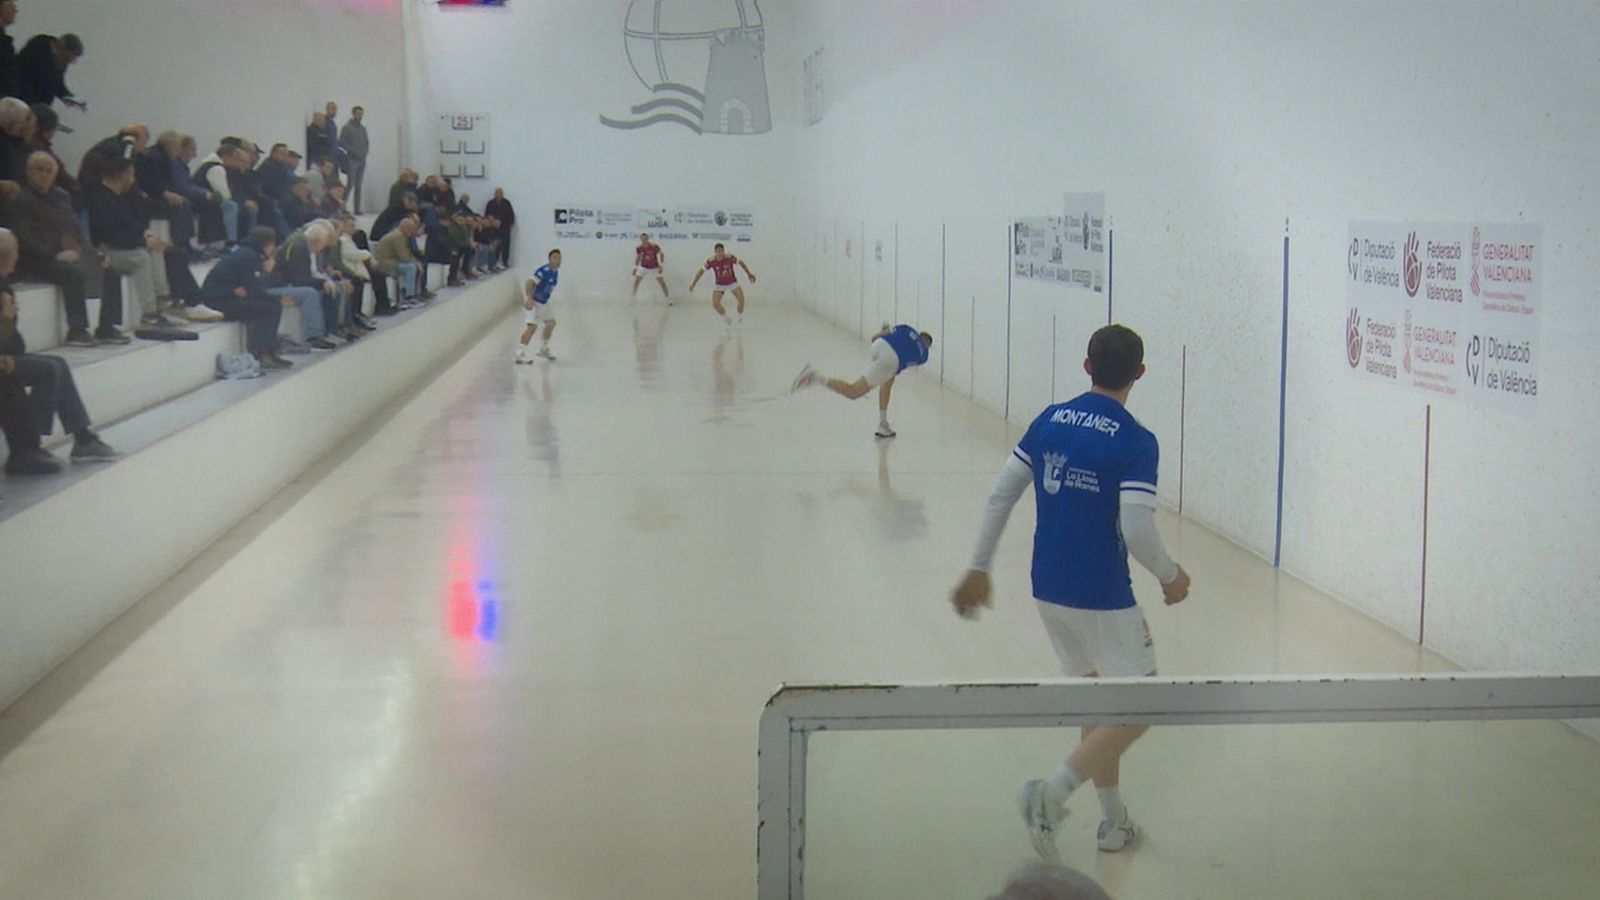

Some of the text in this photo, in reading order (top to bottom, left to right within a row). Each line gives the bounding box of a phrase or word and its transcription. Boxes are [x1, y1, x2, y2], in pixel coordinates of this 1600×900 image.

[568, 208, 594, 217] Pilota
[568, 216, 584, 225] Pro
[1364, 238, 1396, 260] Diputació
[1426, 240, 1462, 260] Federació
[1483, 243, 1535, 262] GENERALITAT
[1363, 266, 1400, 288] de València
[1426, 261, 1457, 281] de Pilota
[1483, 265, 1532, 283] VALENCIANA
[1426, 282, 1463, 303] Valenciana
[1366, 318, 1397, 340] Federació
[1413, 325, 1457, 347] GENERALITAT
[1366, 339, 1392, 358] de Pilota
[1414, 347, 1455, 366] VALENCIANA
[1488, 336, 1531, 364] Diputació
[1365, 356, 1397, 380] Valenciana
[1487, 370, 1538, 396] de València
[1050, 408, 1120, 437] MONTANER
[1064, 479, 1074, 488] de
[1066, 470, 1076, 480] La
[1077, 472, 1098, 485] Llosa
